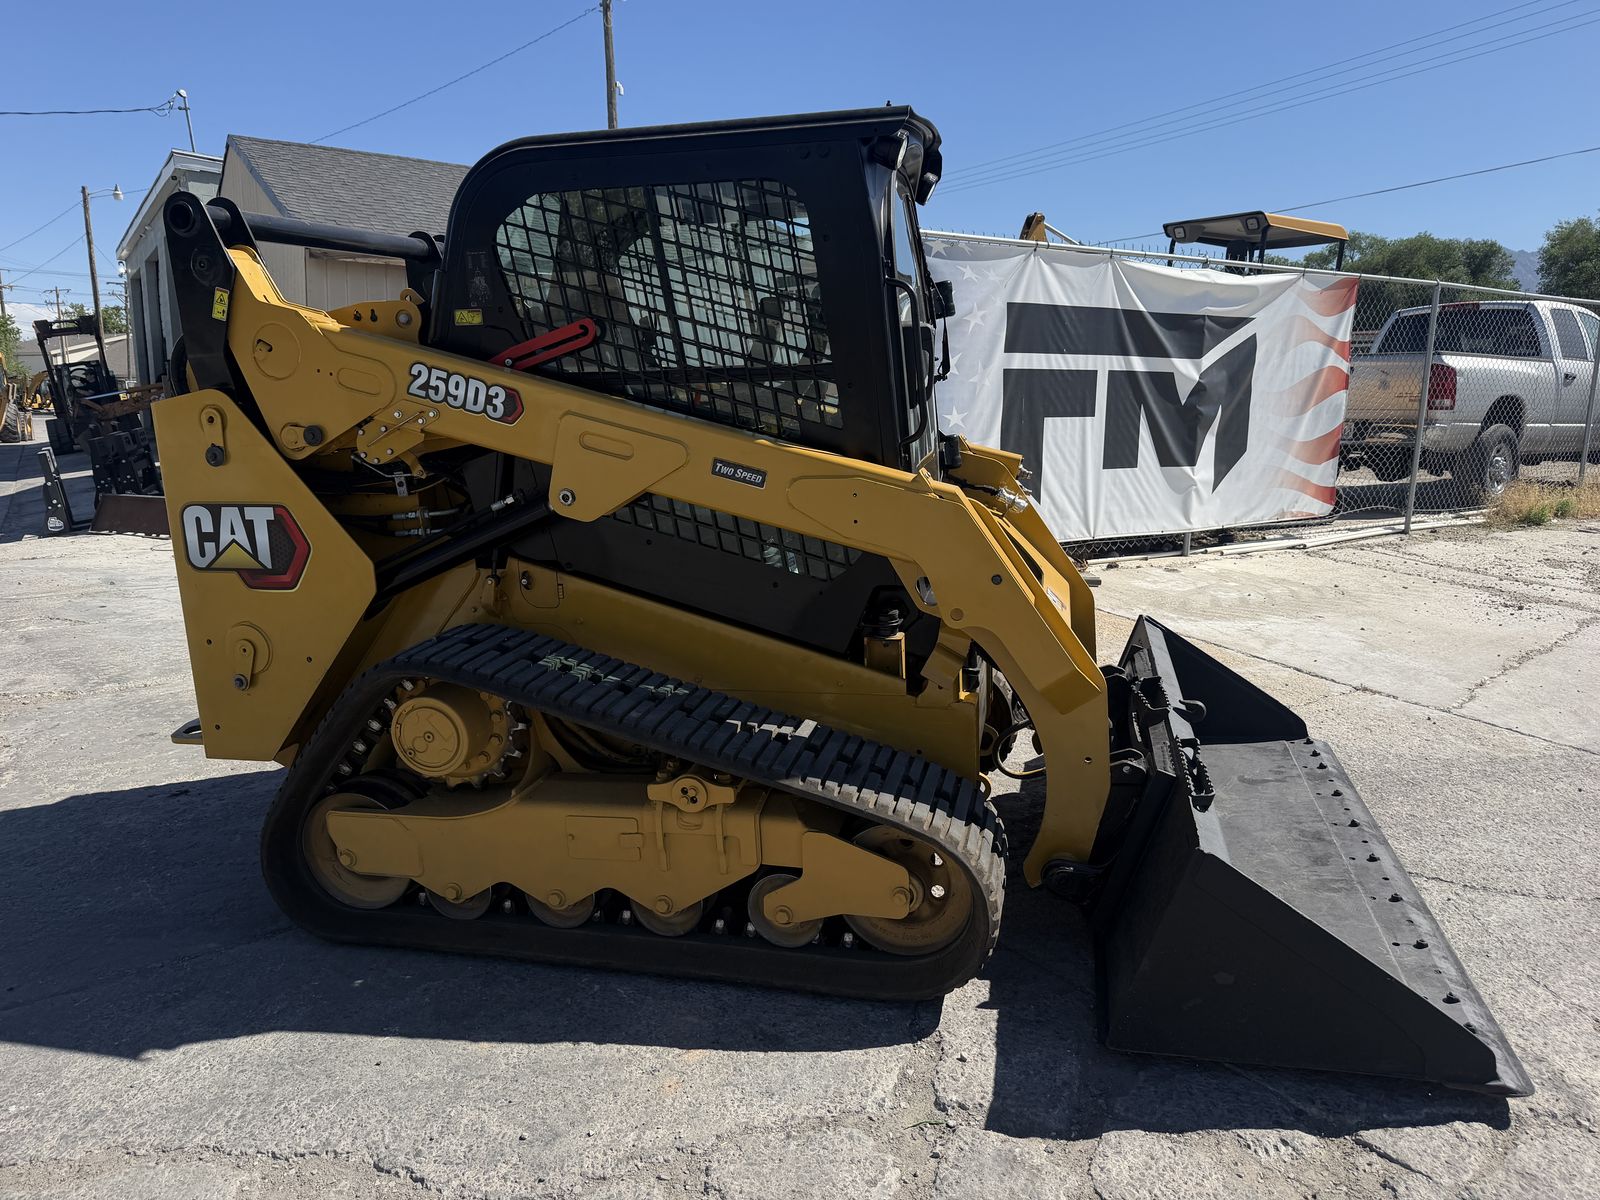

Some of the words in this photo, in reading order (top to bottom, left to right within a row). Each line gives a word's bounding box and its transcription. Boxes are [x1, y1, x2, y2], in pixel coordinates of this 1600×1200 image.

[408, 363, 506, 419] 259D3
[715, 462, 735, 476] TWO
[735, 468, 763, 483] SPEED
[183, 505, 275, 569] CAT
